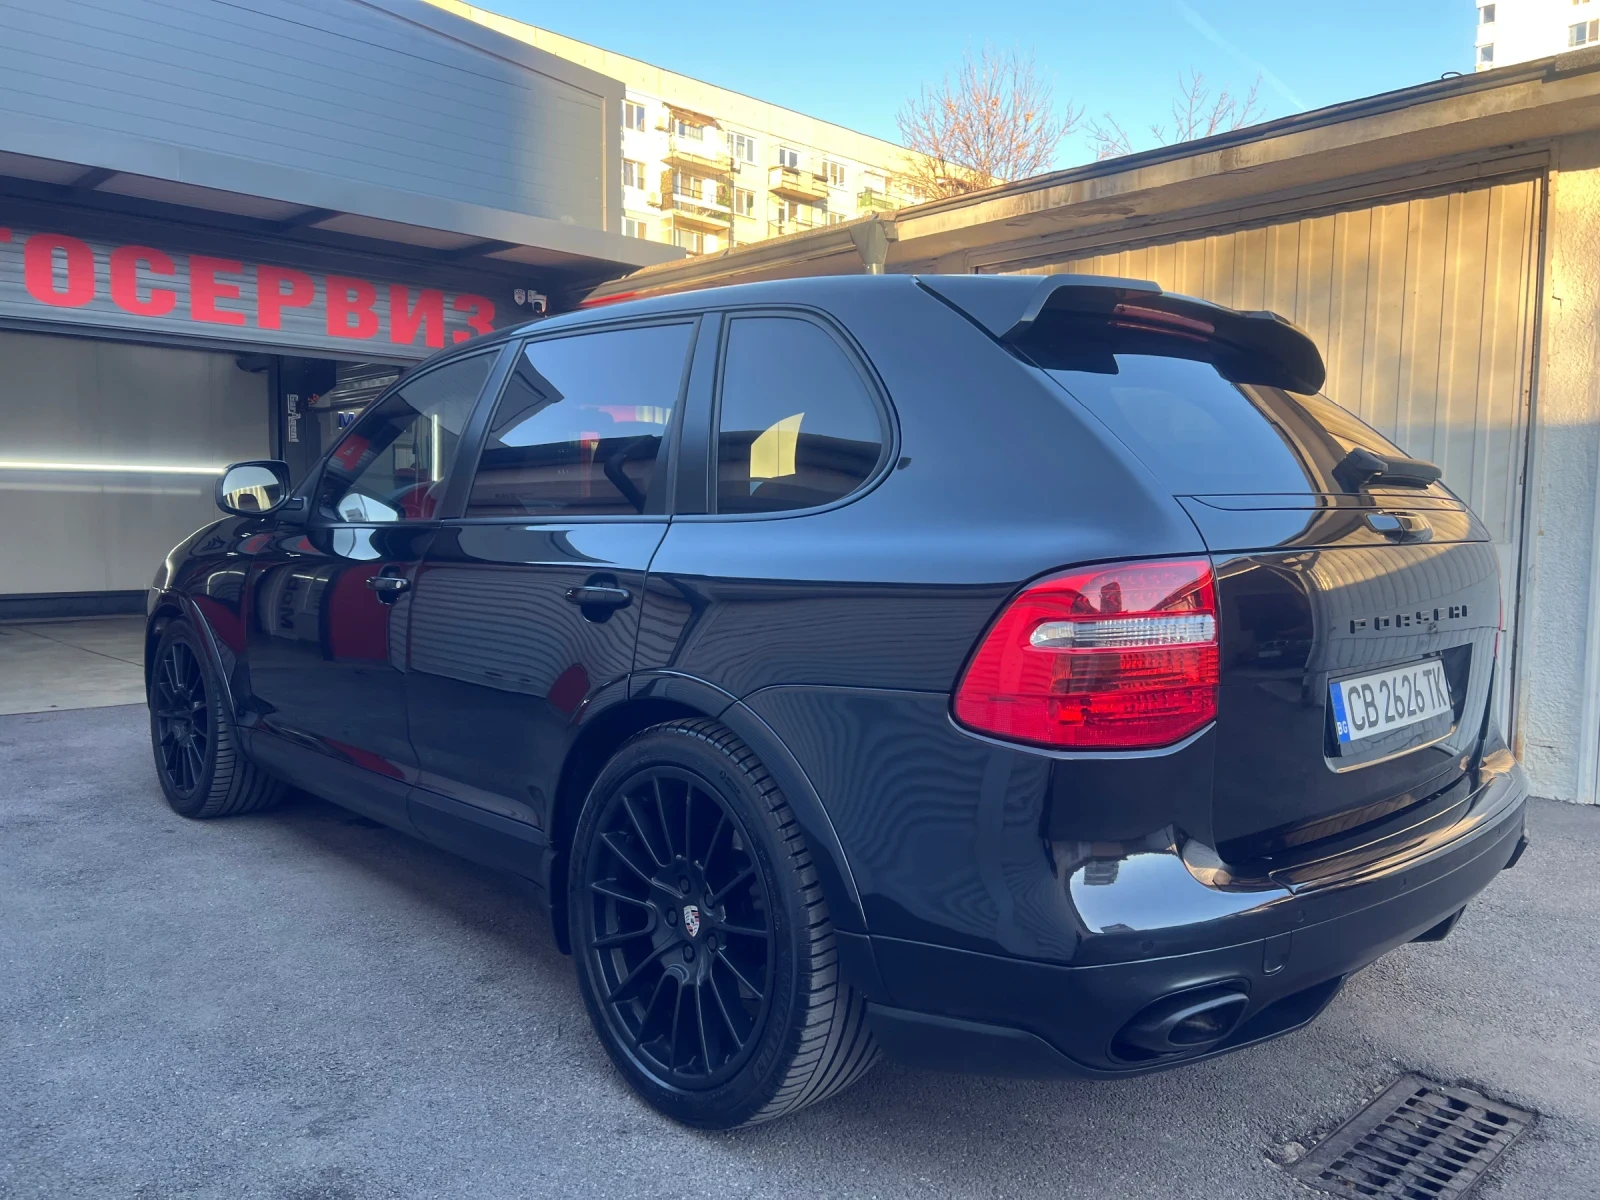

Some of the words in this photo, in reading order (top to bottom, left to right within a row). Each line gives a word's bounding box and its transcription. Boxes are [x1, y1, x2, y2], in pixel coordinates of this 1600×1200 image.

[0, 228, 496, 348] ОСЕРВИЗ
[1350, 604, 1473, 634] PORSCHE
[1347, 683, 1380, 732] CB
[1379, 672, 1426, 724] 2626
[1422, 666, 1448, 711] TK
[1337, 721, 1349, 735] BG
